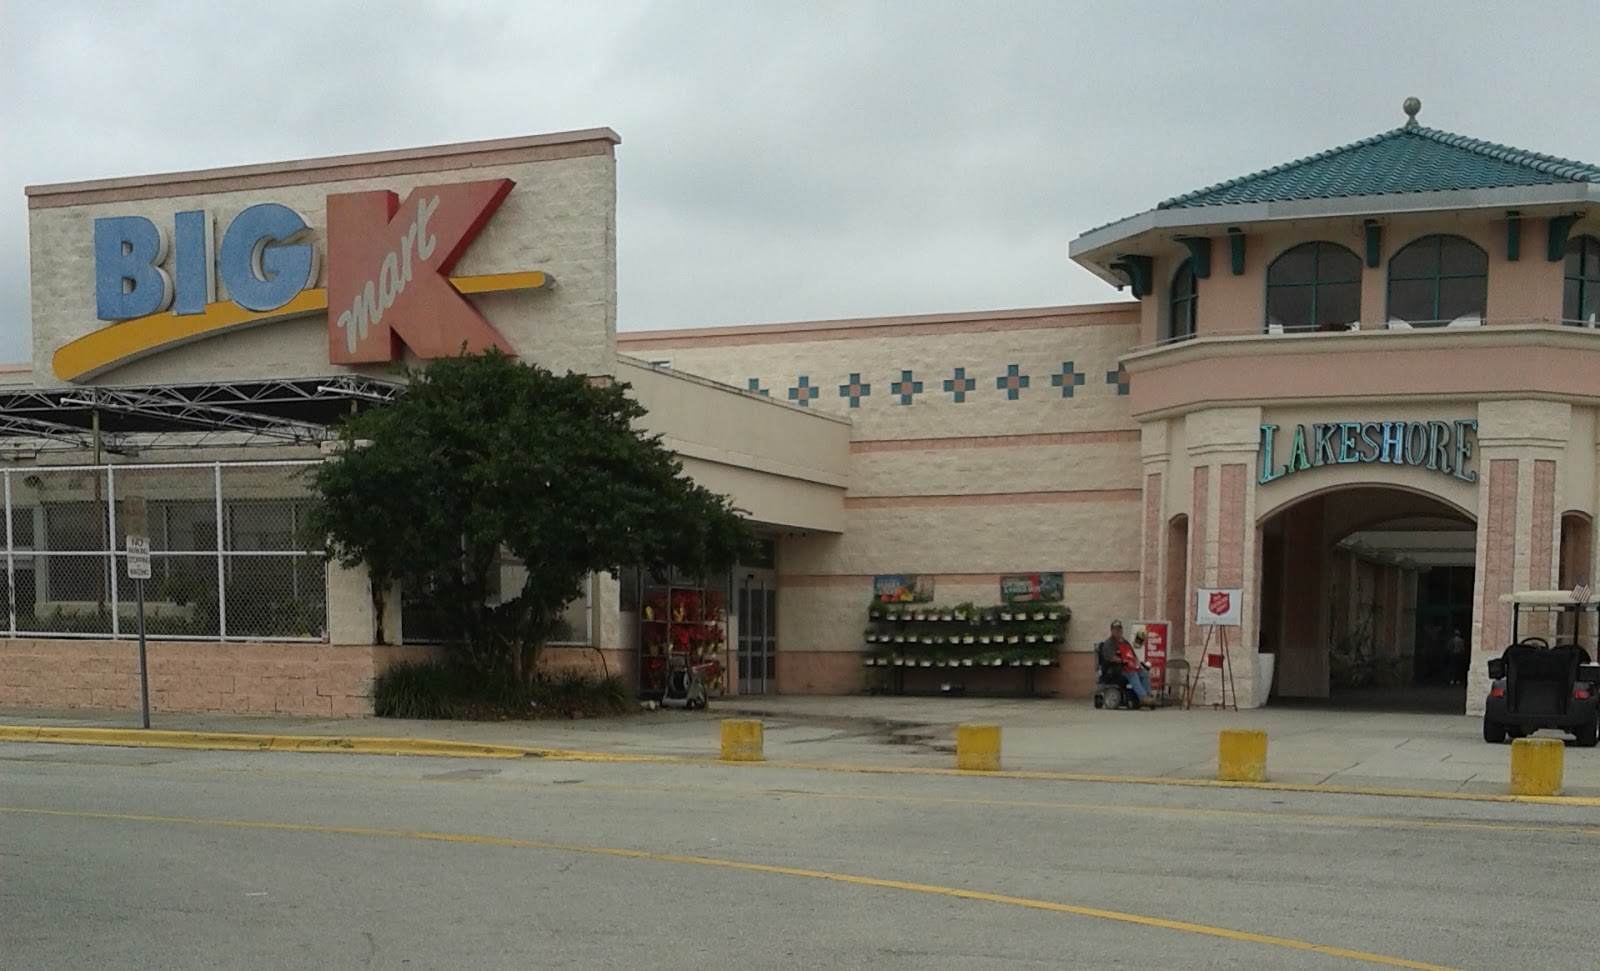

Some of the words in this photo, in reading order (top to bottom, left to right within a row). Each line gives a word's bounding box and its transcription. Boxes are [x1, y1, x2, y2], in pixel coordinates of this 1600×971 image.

[95, 203, 315, 320] BIG
[327, 178, 516, 365] K
[337, 195, 440, 354] mart
[1258, 419, 1478, 485] LAKESHORE
[131, 538, 144, 547] NO
